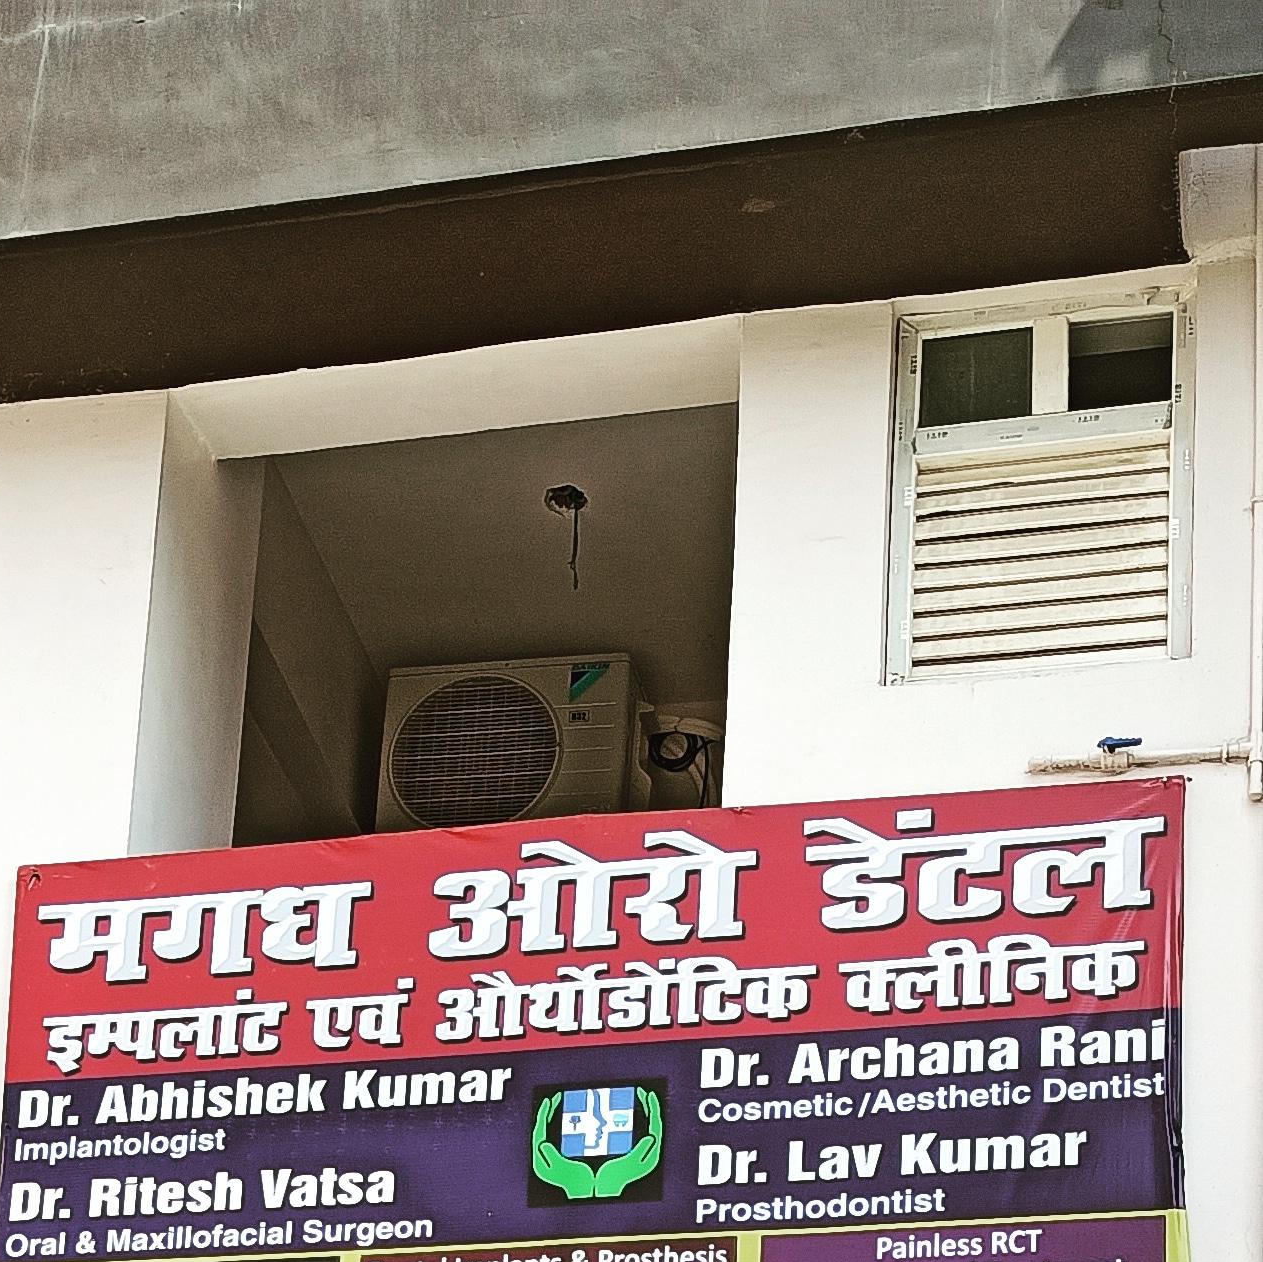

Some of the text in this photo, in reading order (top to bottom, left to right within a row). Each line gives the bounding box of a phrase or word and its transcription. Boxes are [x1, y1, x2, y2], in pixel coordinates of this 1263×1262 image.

[38, 809, 1164, 981] मगध ओरो डेंटल
[43, 989, 287, 1072] इम्पलांट
[306, 978, 413, 1047] एवं
[839, 934, 1144, 1012] क्लीनिक
[701, 1019, 1166, 1088] Dr. Archana Rani
[18, 1068, 511, 1128] Dr. Abhishek Kumar
[1044, 1073, 1165, 1102] Dentist
[15, 1127, 225, 1164] Implantologist
[698, 1131, 1086, 1185] Dr. Lav Kumar
[9, 1168, 394, 1221] Dr. Ritesh Vatsa
[696, 1190, 946, 1223] Prosthodontist
[6, 1219, 434, 1257] Oral & Maxillofacial Surgeon
[877, 1229, 1042, 1259] Painless RCT
